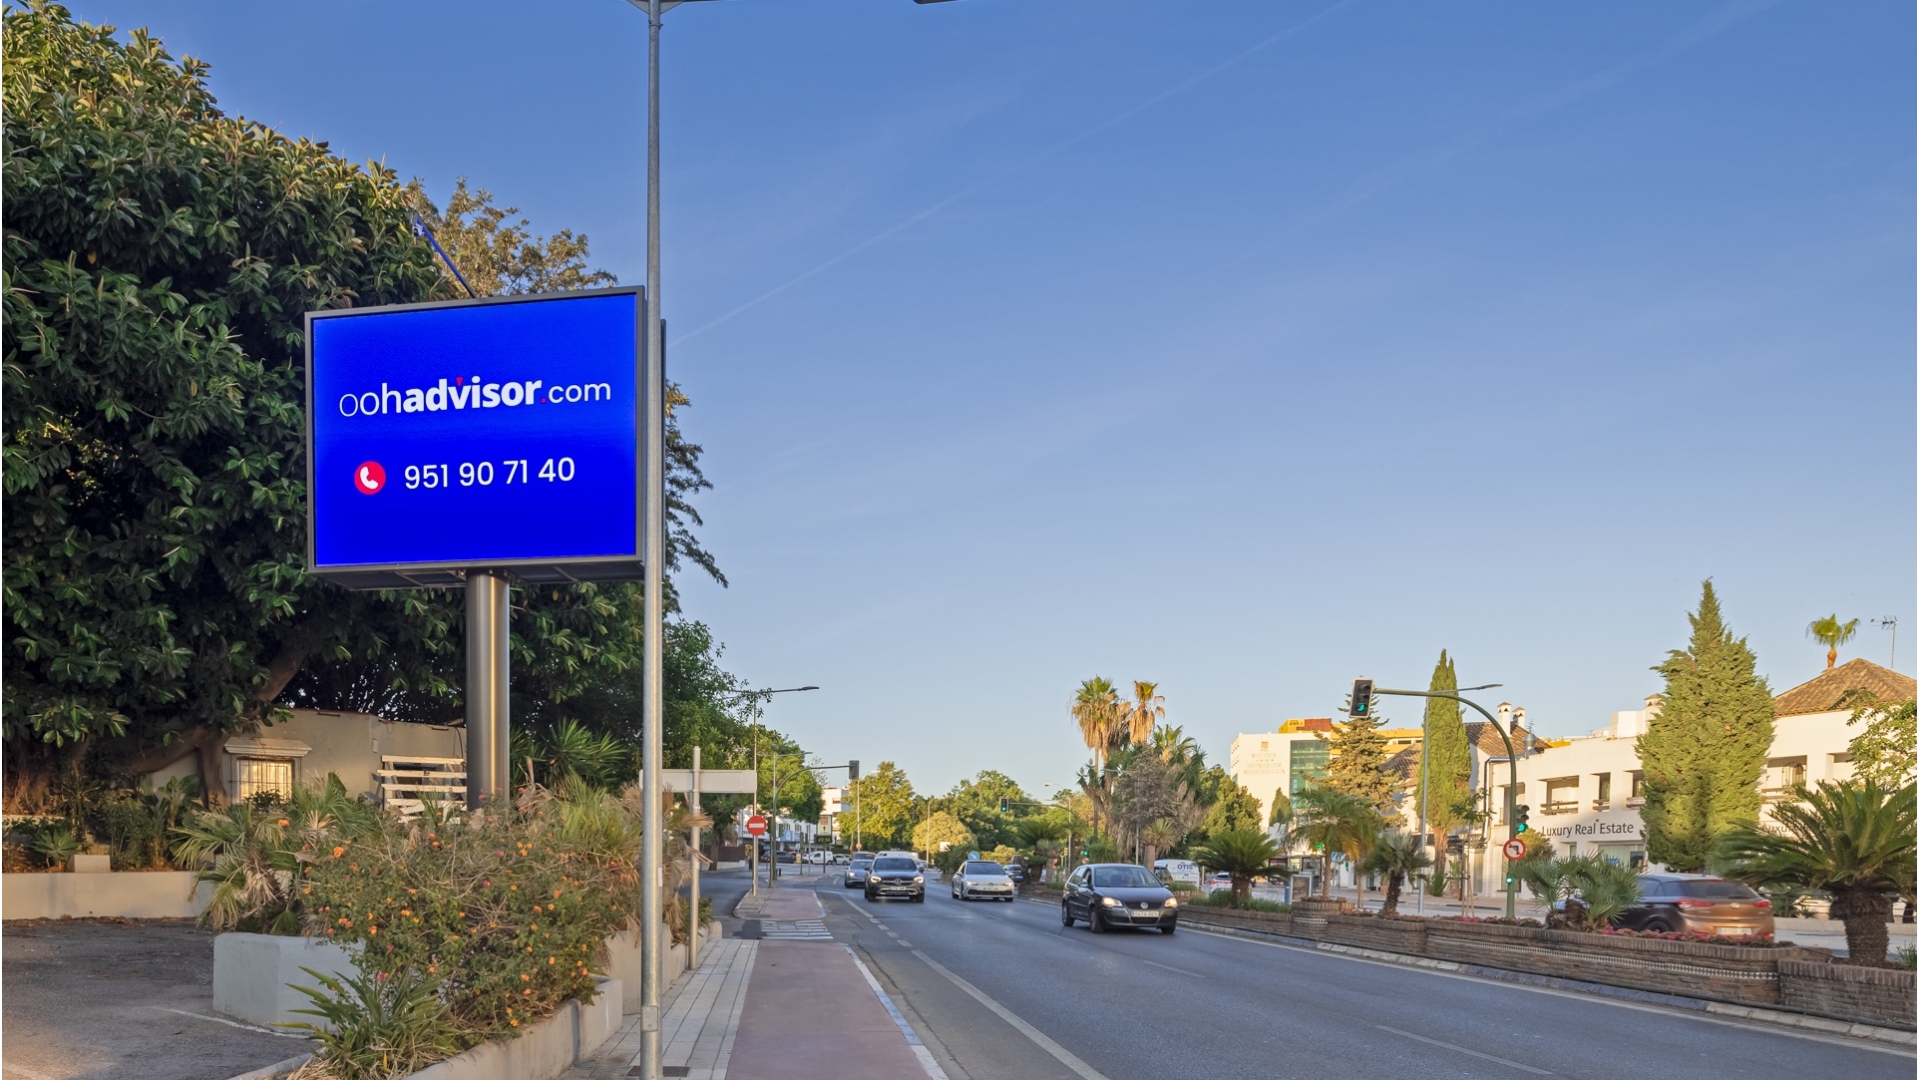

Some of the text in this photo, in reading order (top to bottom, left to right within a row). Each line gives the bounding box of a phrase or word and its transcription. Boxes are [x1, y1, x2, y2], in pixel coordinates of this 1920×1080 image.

[339, 375, 611, 417] oohadvisor.com
[404, 457, 575, 489] 951 90 71 40
[1541, 823, 1634, 838] Luxury Real Estate
